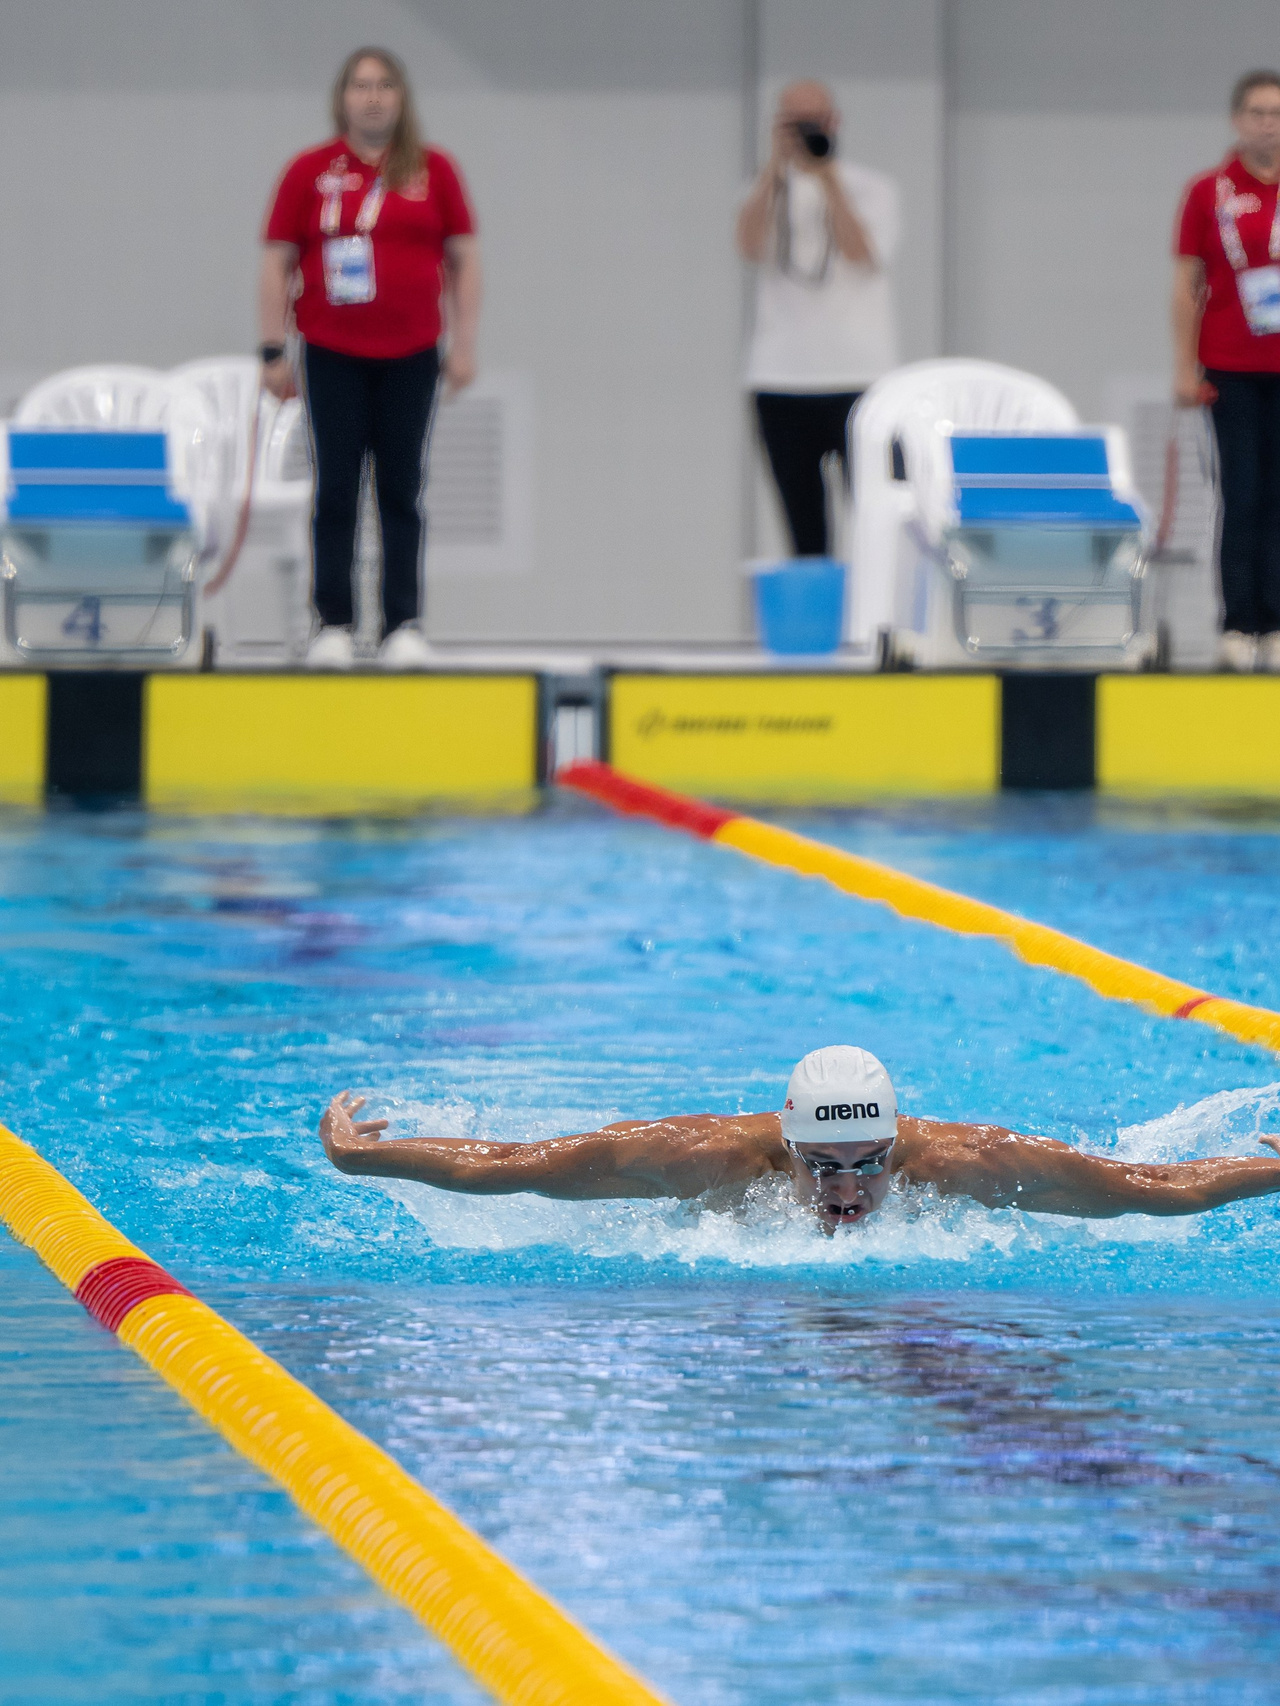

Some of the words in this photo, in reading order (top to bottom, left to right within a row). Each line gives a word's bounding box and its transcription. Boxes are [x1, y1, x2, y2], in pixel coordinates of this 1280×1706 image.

[62, 595, 107, 644] 4
[1011, 597, 1059, 644] 3
[815, 1103, 879, 1121] arena
